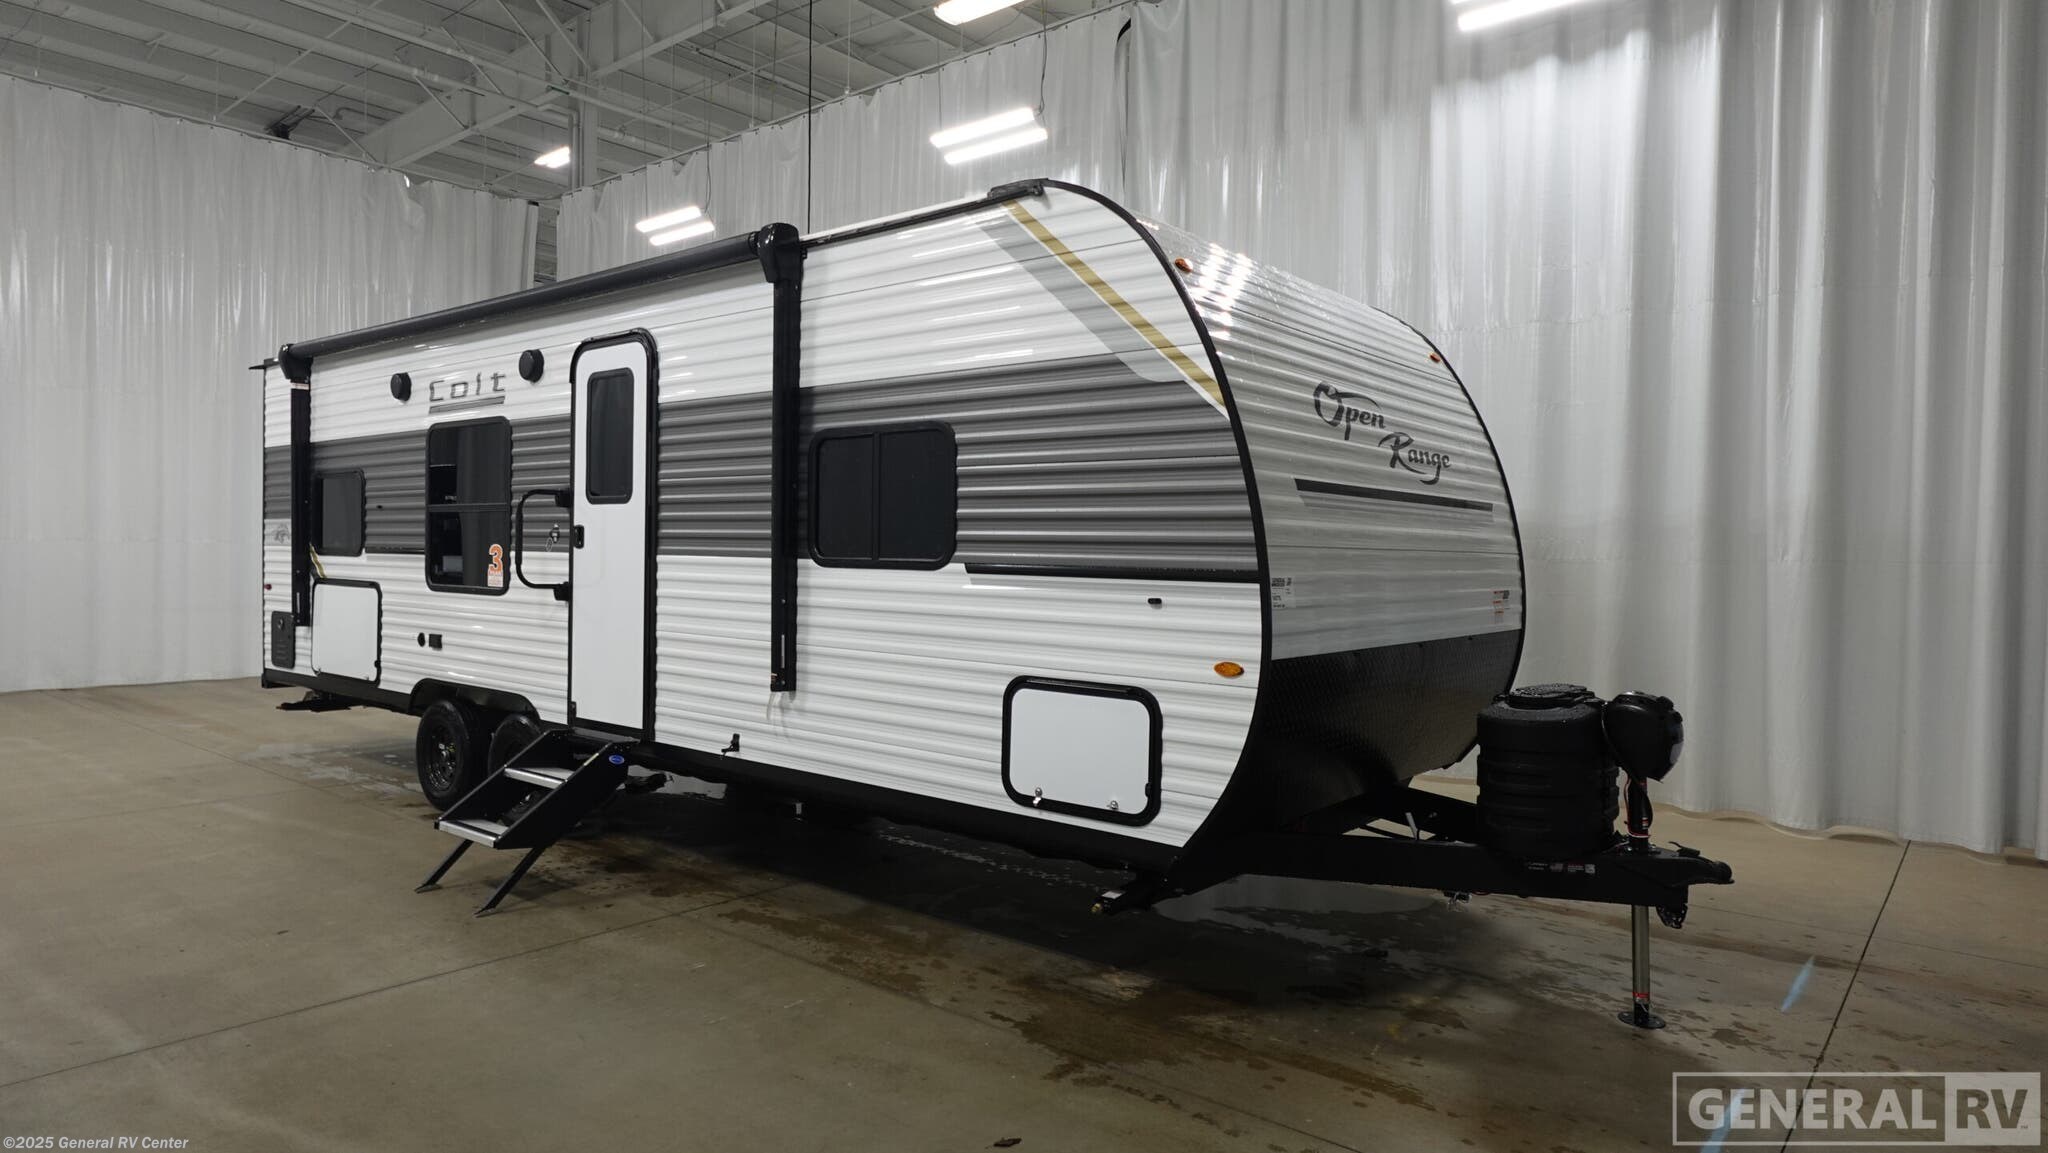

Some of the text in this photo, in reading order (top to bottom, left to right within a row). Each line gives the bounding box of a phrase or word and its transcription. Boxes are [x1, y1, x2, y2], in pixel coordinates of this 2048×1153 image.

[429, 372, 506, 402] Colt
[1313, 381, 1387, 441] Open
[1378, 431, 1451, 486] Range
[489, 544, 503, 573] 3
